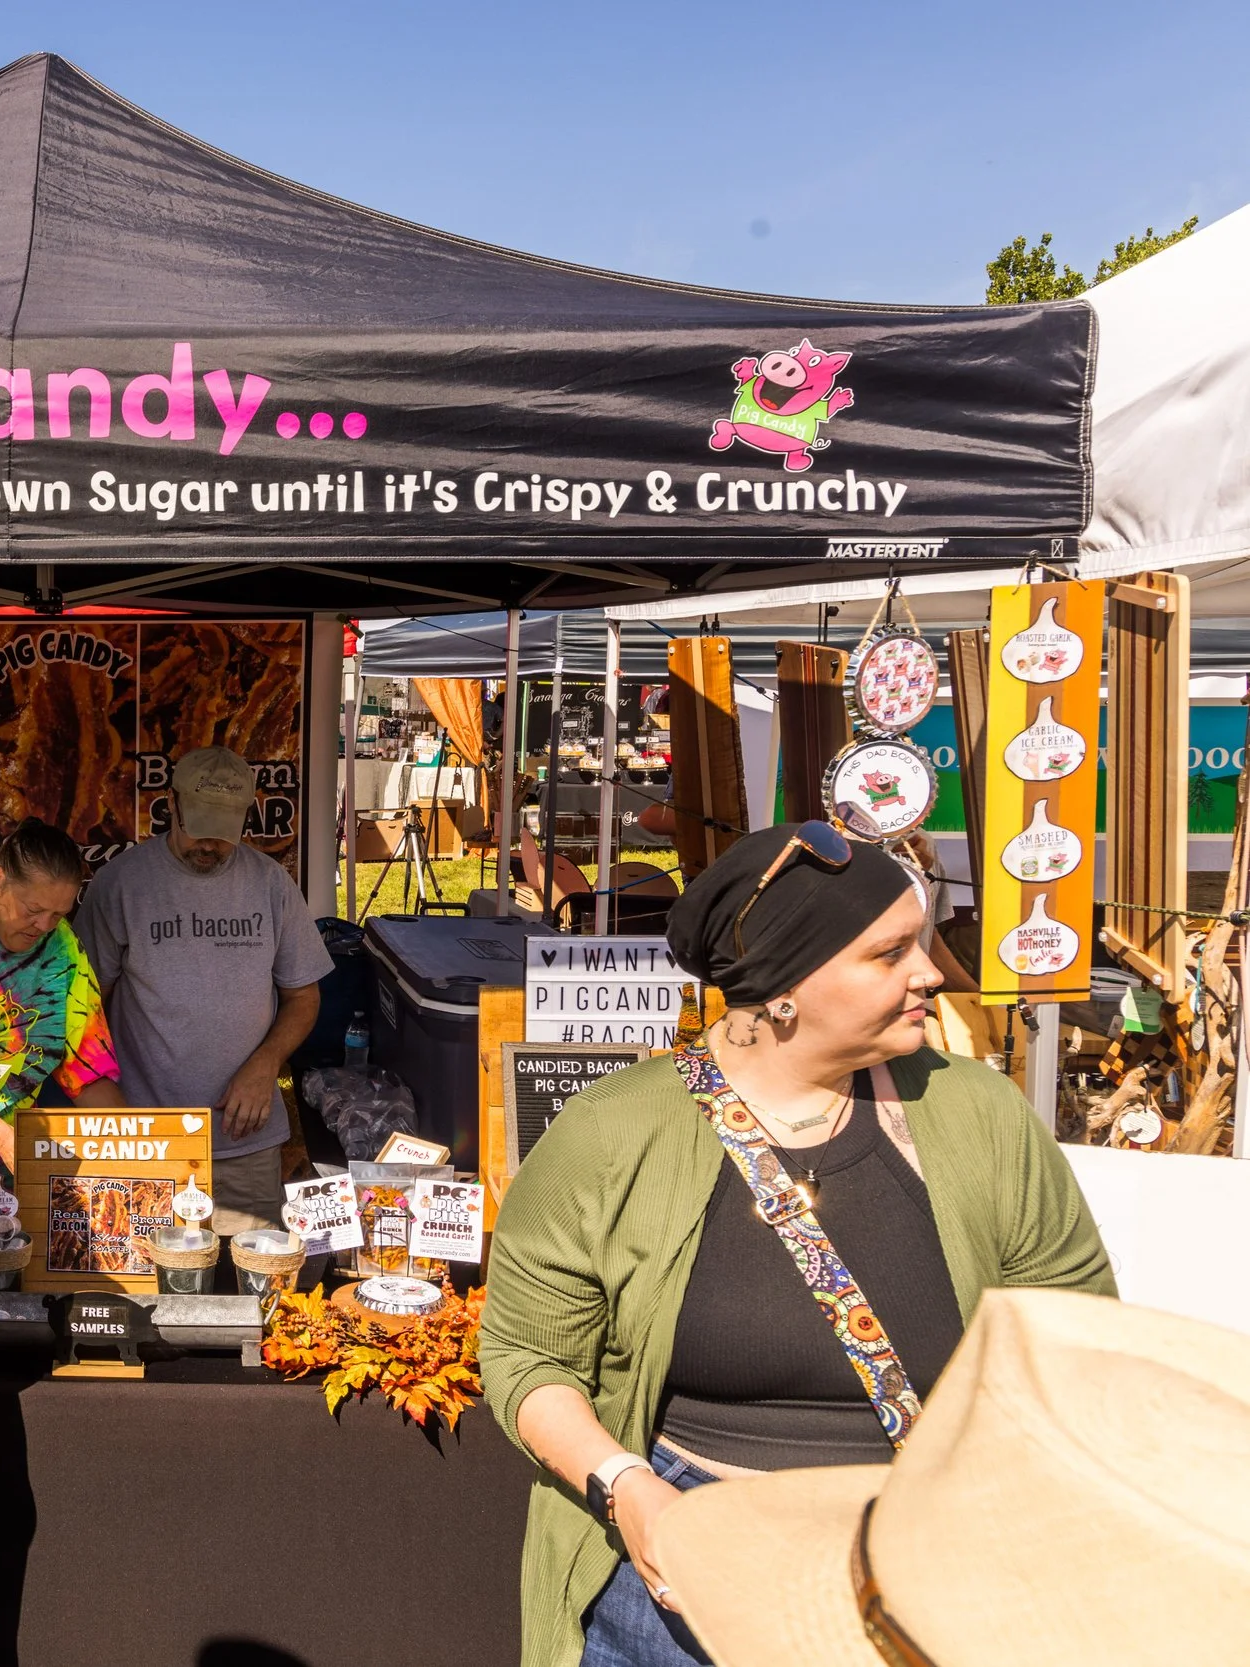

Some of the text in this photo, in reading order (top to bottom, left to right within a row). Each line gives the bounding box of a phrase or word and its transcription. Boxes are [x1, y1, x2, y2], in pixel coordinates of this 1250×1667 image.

[737, 404, 807, 439] Pig Candy
[89, 472, 238, 523] Sugar
[251, 471, 366, 513] until
[385, 472, 459, 514] it's
[475, 471, 632, 522] Crispy
[648, 472, 678, 513] &
[697, 470, 908, 520] Crunchy
[826, 538, 948, 559] MASTERTENT
[40, 629, 133, 681] CANDY
[1028, 725, 1061, 737] GARLIC
[1021, 738, 1035, 748] ICE
[1041, 735, 1074, 747] CREAM
[843, 760, 861, 779] THIS
[866, 749, 888, 760] DAD
[891, 750, 912, 765] BOD
[150, 796, 295, 838] SAR
[880, 807, 920, 831] BACON
[1018, 830, 1068, 846] SMASHED
[151, 912, 263, 945] got bacon?
[1017, 927, 1060, 938] NASHVILLE
[568, 946, 658, 972] I WANT
[517, 1060, 582, 1075] CANDIED
[535, 1080, 596, 1092] PIG CAN
[67, 1117, 155, 1137] I WANT
[34, 1140, 170, 1160] PIG CANDY
[397, 1143, 430, 1160] Crunch
[93, 1182, 129, 1194] PIG CANDY
[433, 1184, 467, 1200] PC
[437, 1198, 461, 1212] PIG
[53, 1210, 172, 1225] Real Brown
[312, 1216, 352, 1232] UNCH
[429, 1208, 469, 1224] PILE
[53, 1220, 163, 1237] BACON SUG
[423, 1221, 472, 1233] CRUNCH
[91, 1233, 131, 1243] Slow
[421, 1230, 475, 1241] Roasted Garlic
[90, 1245, 131, 1253] ROASTED
[420, 1248, 470, 1257] iwantpigcandy.com
[82, 1306, 110, 1319] FREE
[70, 1321, 125, 1335] SAMPLES
